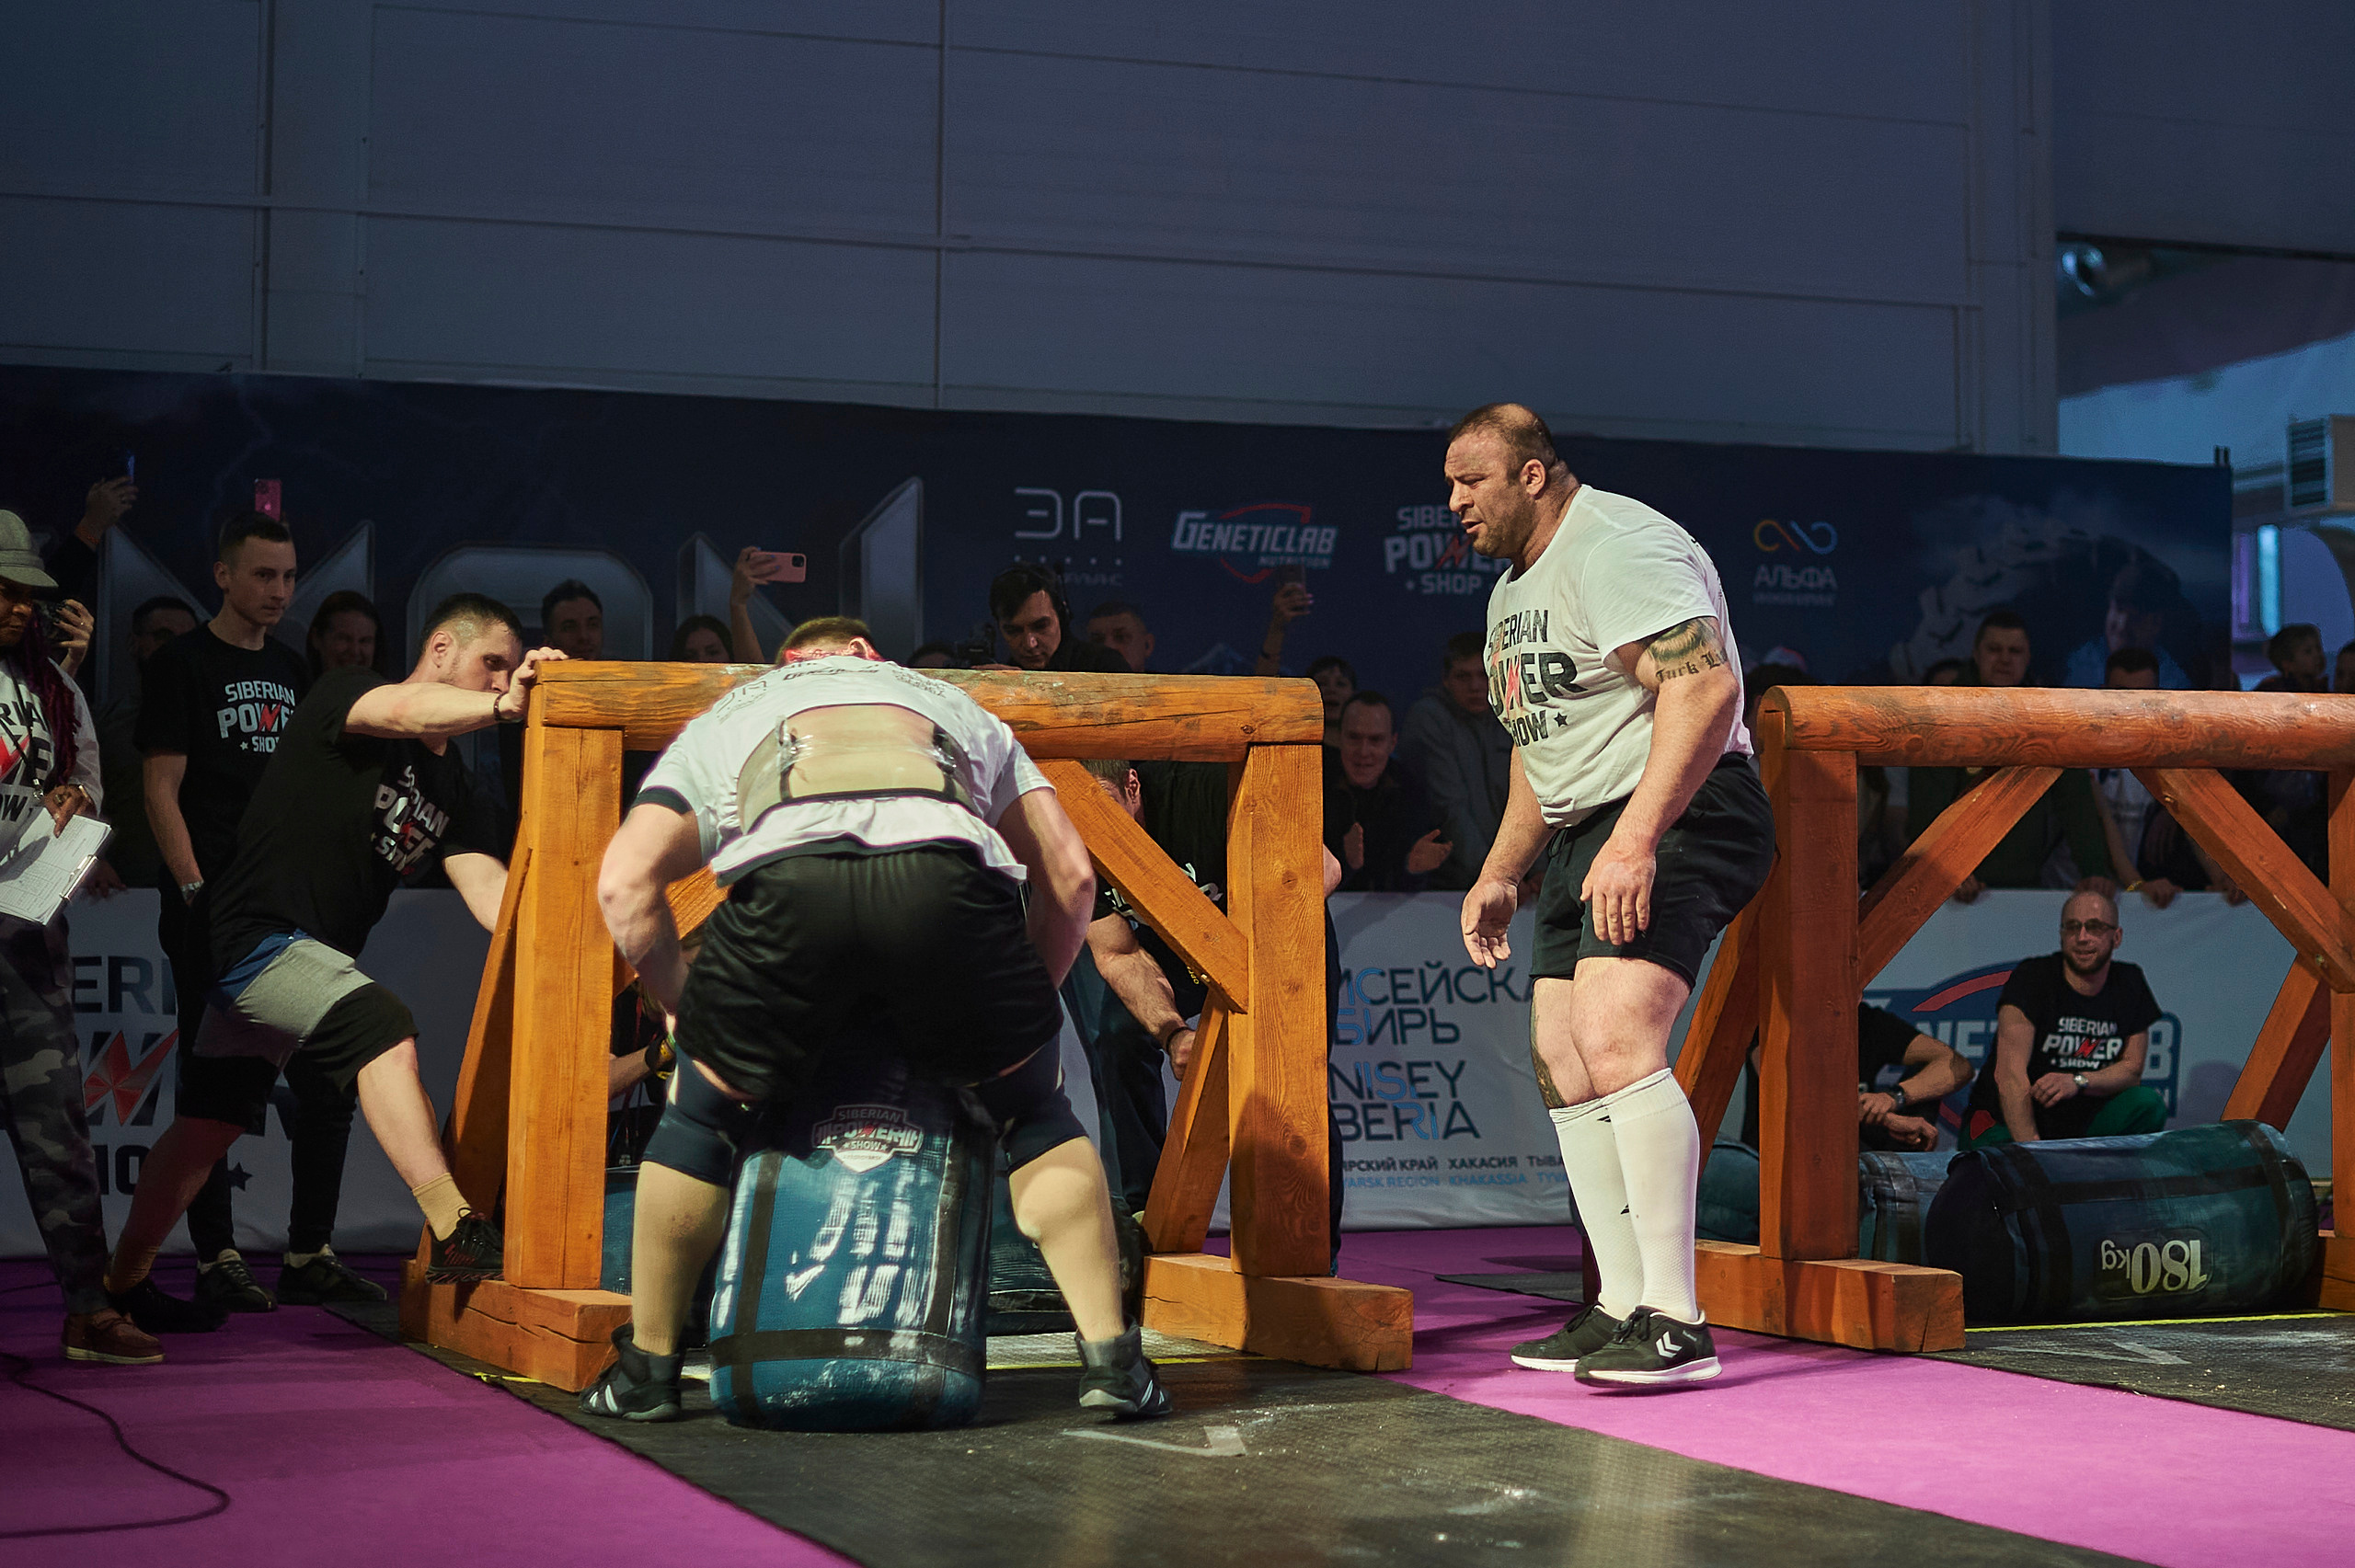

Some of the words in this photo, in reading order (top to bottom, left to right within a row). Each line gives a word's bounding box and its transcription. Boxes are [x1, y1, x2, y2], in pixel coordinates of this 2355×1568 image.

[1172, 510, 1337, 555] GENETICLAB
[1421, 571, 1482, 594] SHOP
[1753, 564, 1838, 589] АЛЬФА
[224, 681, 295, 706] SIBERIAN
[1488, 646, 1588, 716] OWER
[216, 701, 294, 738] POWE
[251, 736, 280, 753] SHO
[1335, 1008, 1460, 1045] БИРЬ
[2041, 1034, 2123, 1060] POWER
[2059, 1059, 2100, 1070] SHOW
[1328, 1060, 1466, 1101] NISEY
[839, 1108, 901, 1123] SIBERIAN
[1333, 1101, 1481, 1141] BERIA
[851, 1140, 880, 1150] SHOW
[1398, 1156, 1438, 1171] КРАЙ
[1448, 1156, 1518, 1169] ХАКАСИЯ
